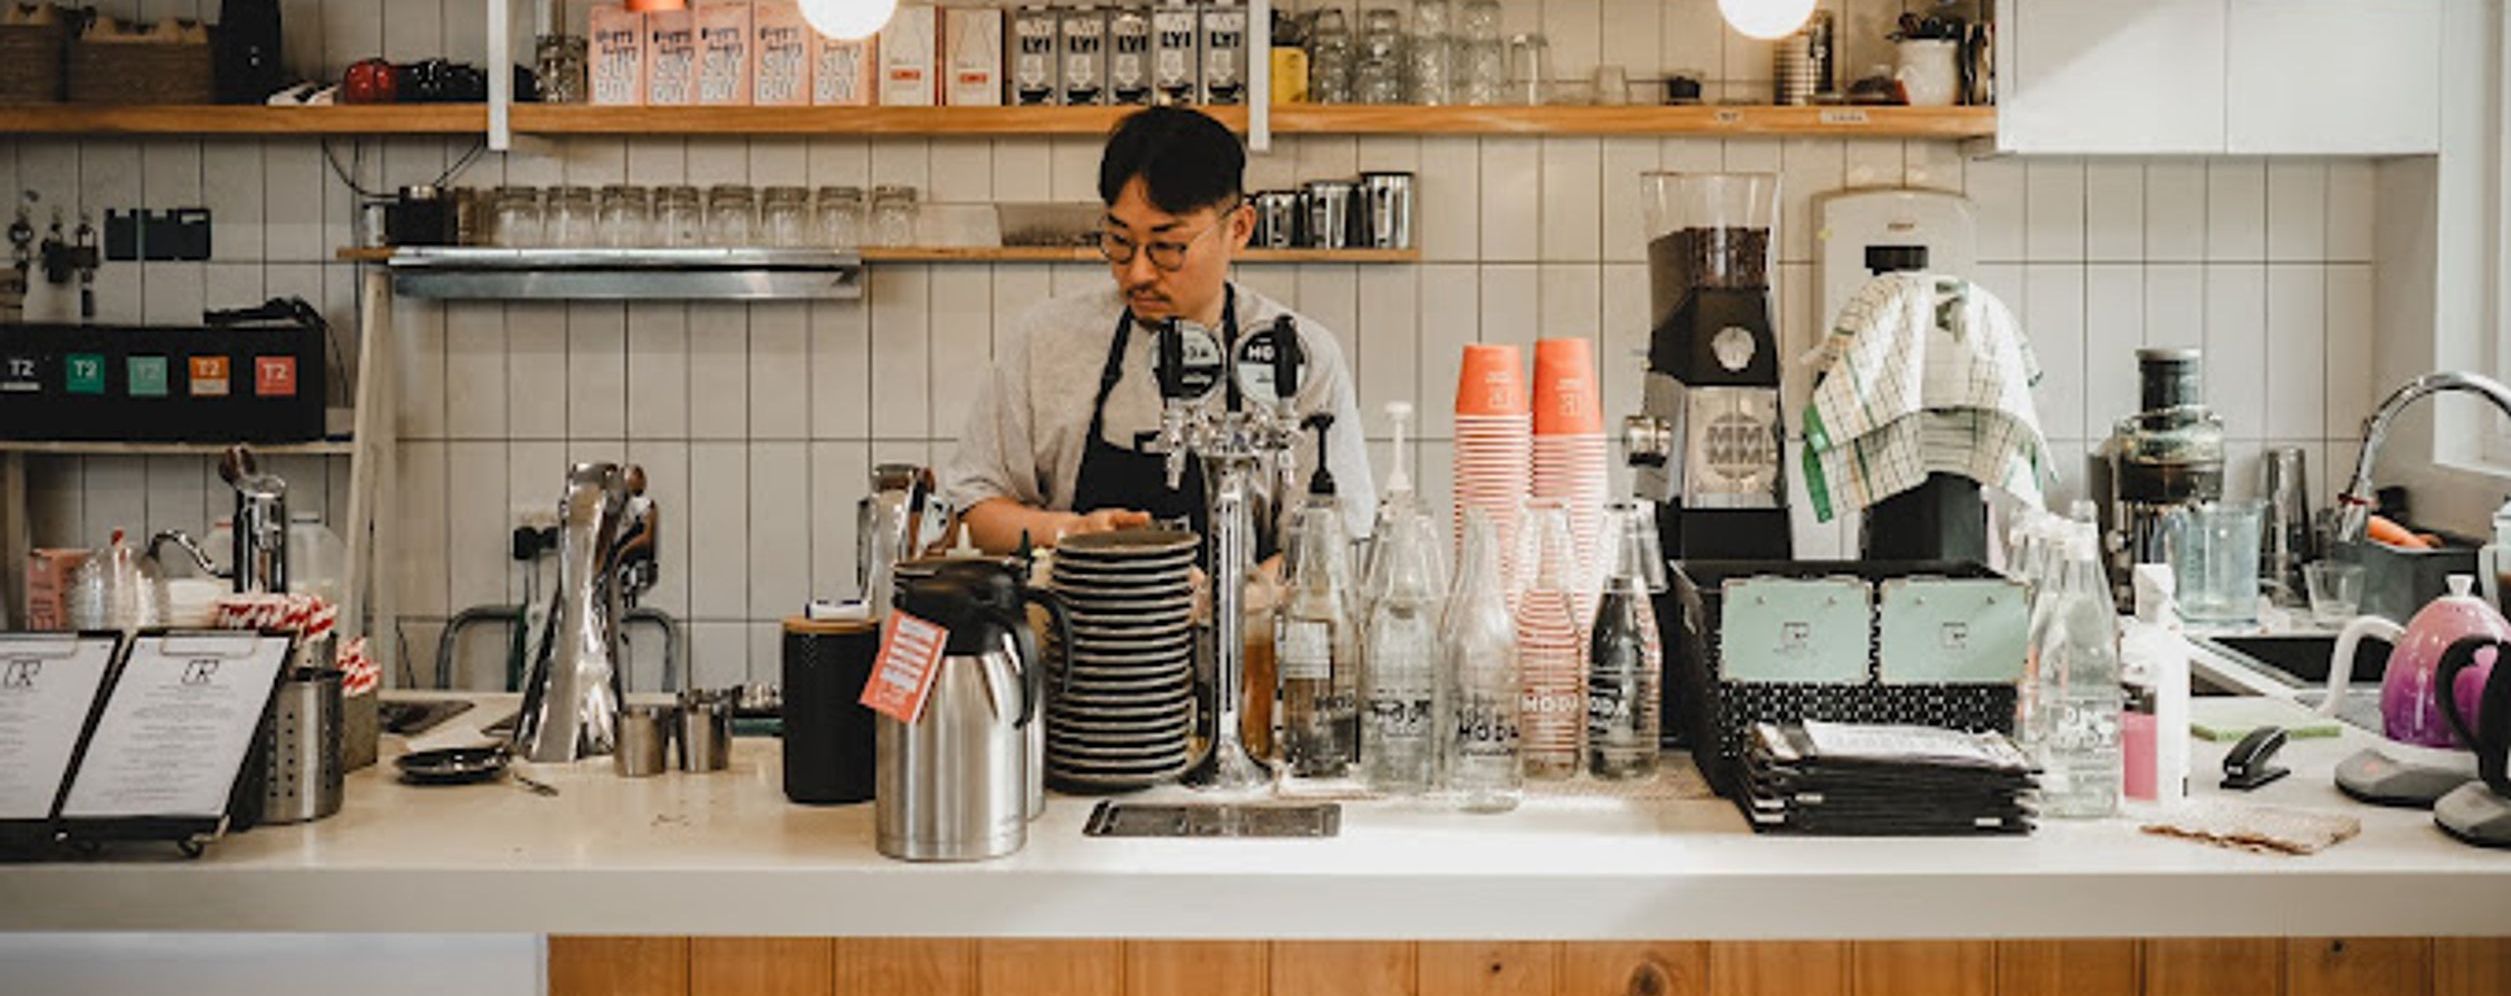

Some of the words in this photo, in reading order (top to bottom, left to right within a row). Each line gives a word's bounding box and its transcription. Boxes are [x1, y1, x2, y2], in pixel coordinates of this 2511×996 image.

[10, 359, 35, 376] T2
[74, 360, 98, 377] T2
[138, 363, 161, 380] T2
[197, 359, 220, 376] T2
[264, 363, 288, 380] T2
